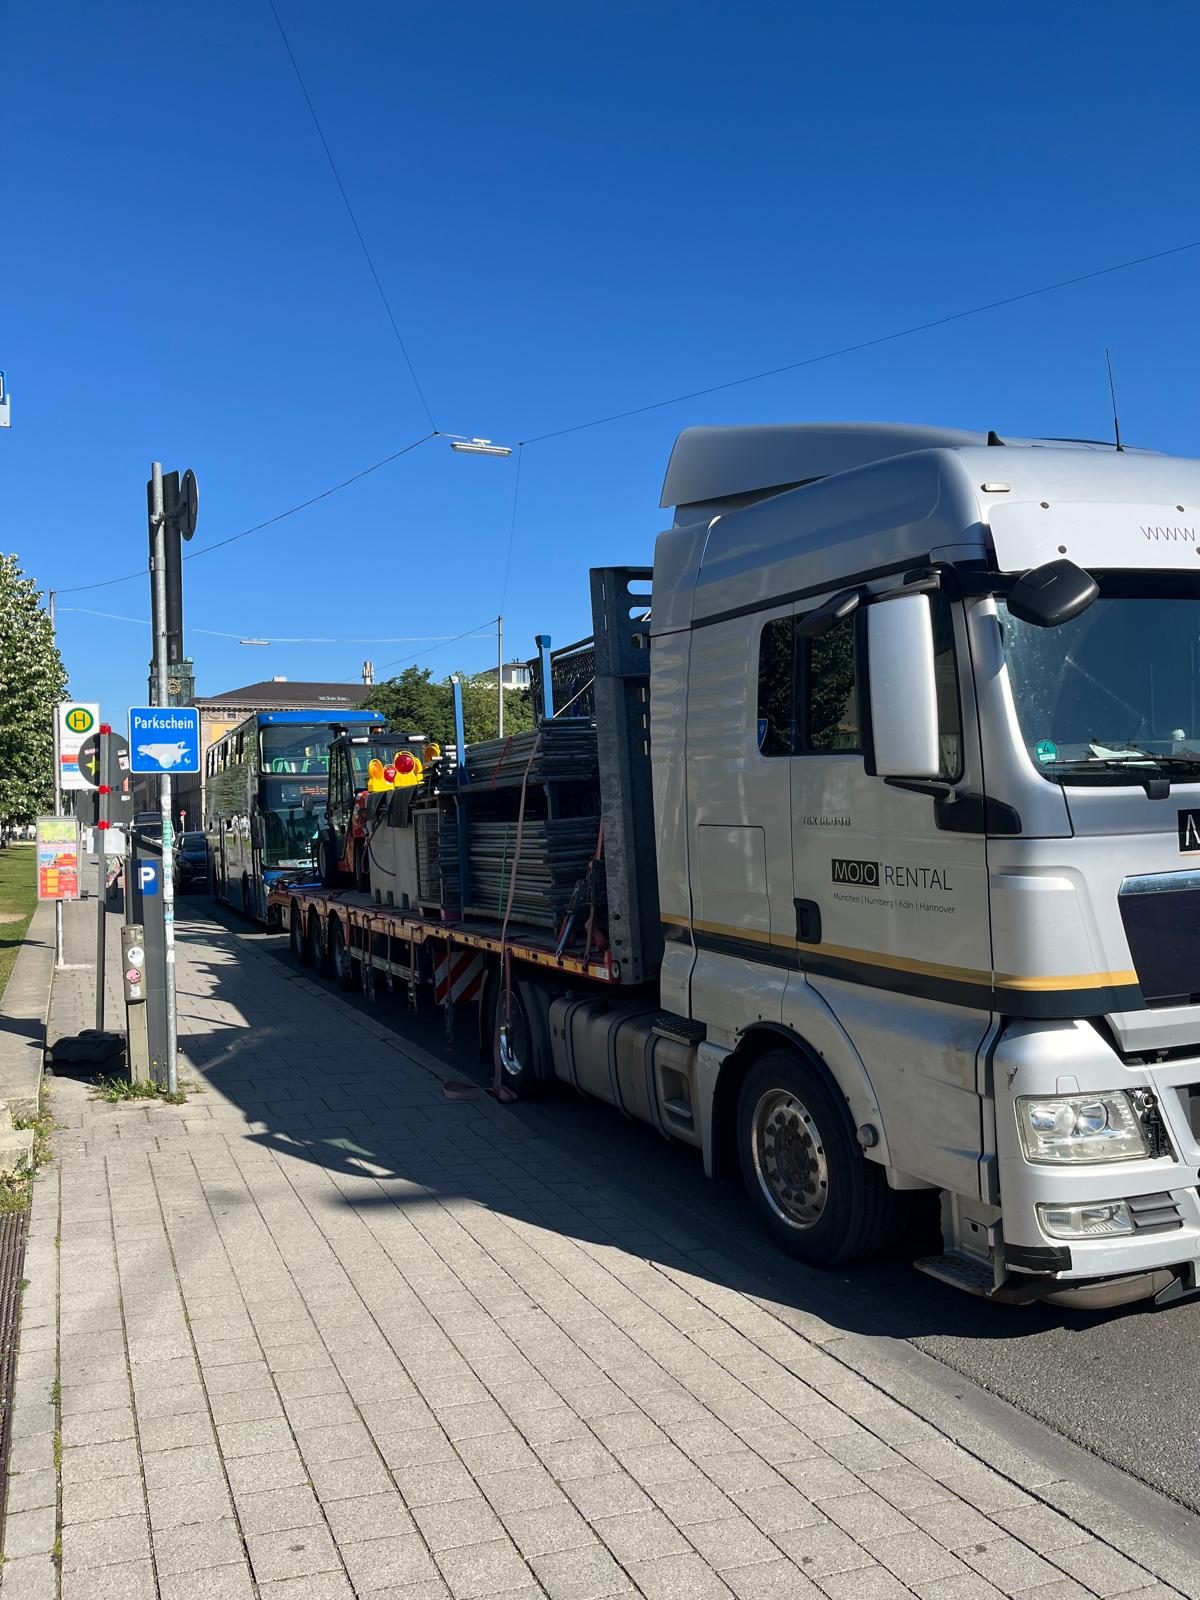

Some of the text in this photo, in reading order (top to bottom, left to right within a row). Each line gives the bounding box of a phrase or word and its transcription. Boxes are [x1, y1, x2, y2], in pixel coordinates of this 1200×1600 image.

[73, 713, 86, 727] H
[134, 715, 194, 729] Parkschein
[138, 866, 155, 889] P
[834, 861, 953, 891] MOJO RENTAL
[833, 892, 956, 914] München Nürnberg Köln Hannover
